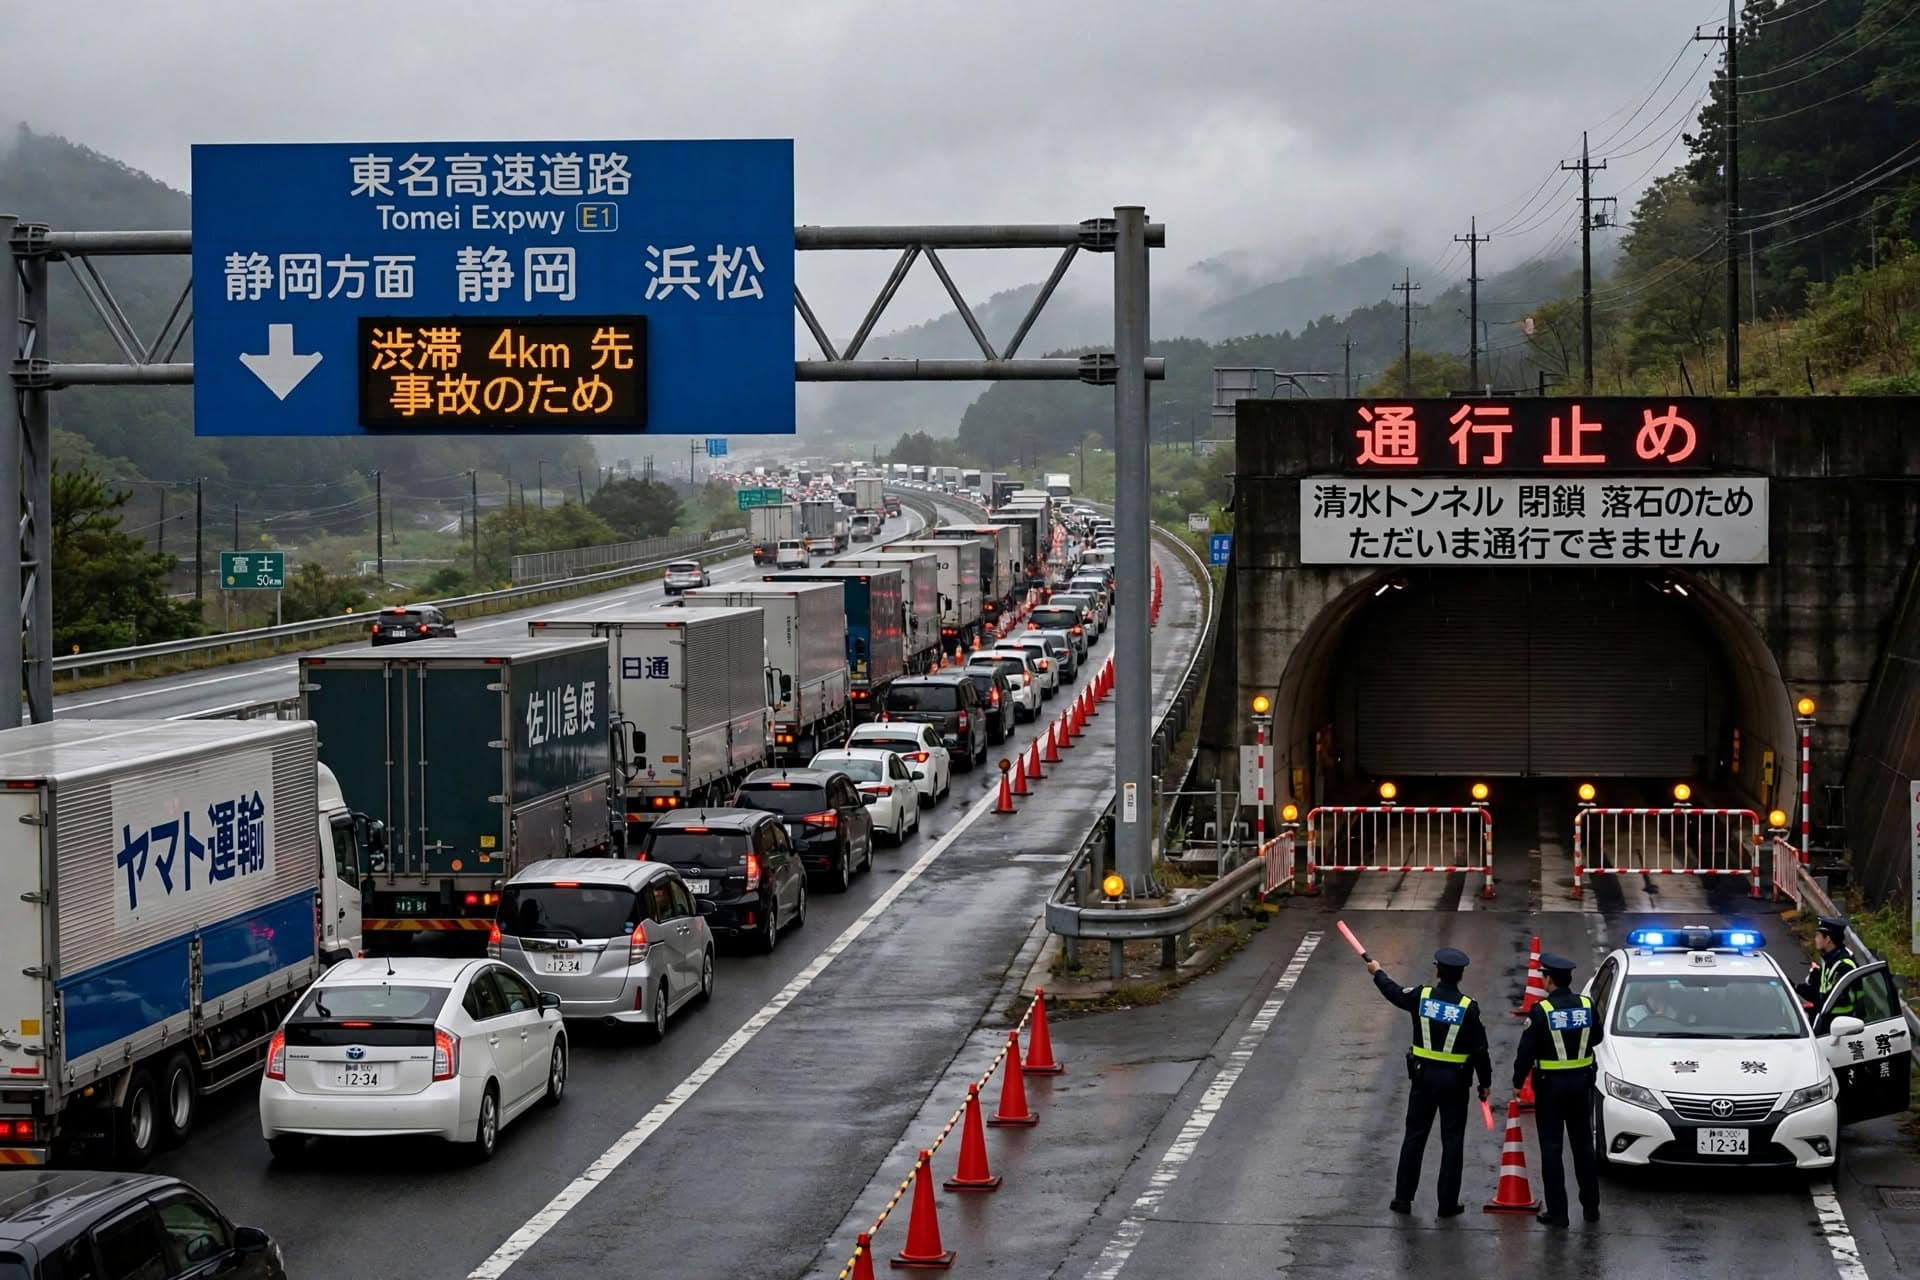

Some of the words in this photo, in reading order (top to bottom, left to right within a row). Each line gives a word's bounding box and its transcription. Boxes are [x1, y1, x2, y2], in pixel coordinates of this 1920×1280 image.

[350, 153, 631, 196] 東名高速道路
[377, 205, 461, 230] Tomei
[472, 206, 565, 234] Expwy
[583, 208, 611, 227] E1
[225, 252, 415, 300] 静岡方面
[456, 246, 575, 302] 静岡
[645, 245, 764, 300] 浜松
[371, 327, 462, 370] 渋滞
[488, 328, 570, 369] 4km
[591, 327, 633, 370] 先
[389, 373, 613, 416] 事故のため
[1356, 405, 1697, 465] 通行止め
[1314, 485, 1504, 518] 清水トンネル
[1518, 485, 1586, 518] 閉鎖
[1601, 485, 1754, 518] 落石のため
[232, 556, 274, 573] 富士
[1349, 526, 1720, 560] ただいま通行できません
[622, 656, 670, 680] 日通
[526, 681, 596, 748] 佐川急便
[117, 790, 265, 911] ヤマト運輸
[1710, 1138, 1746, 1153] 12-34
